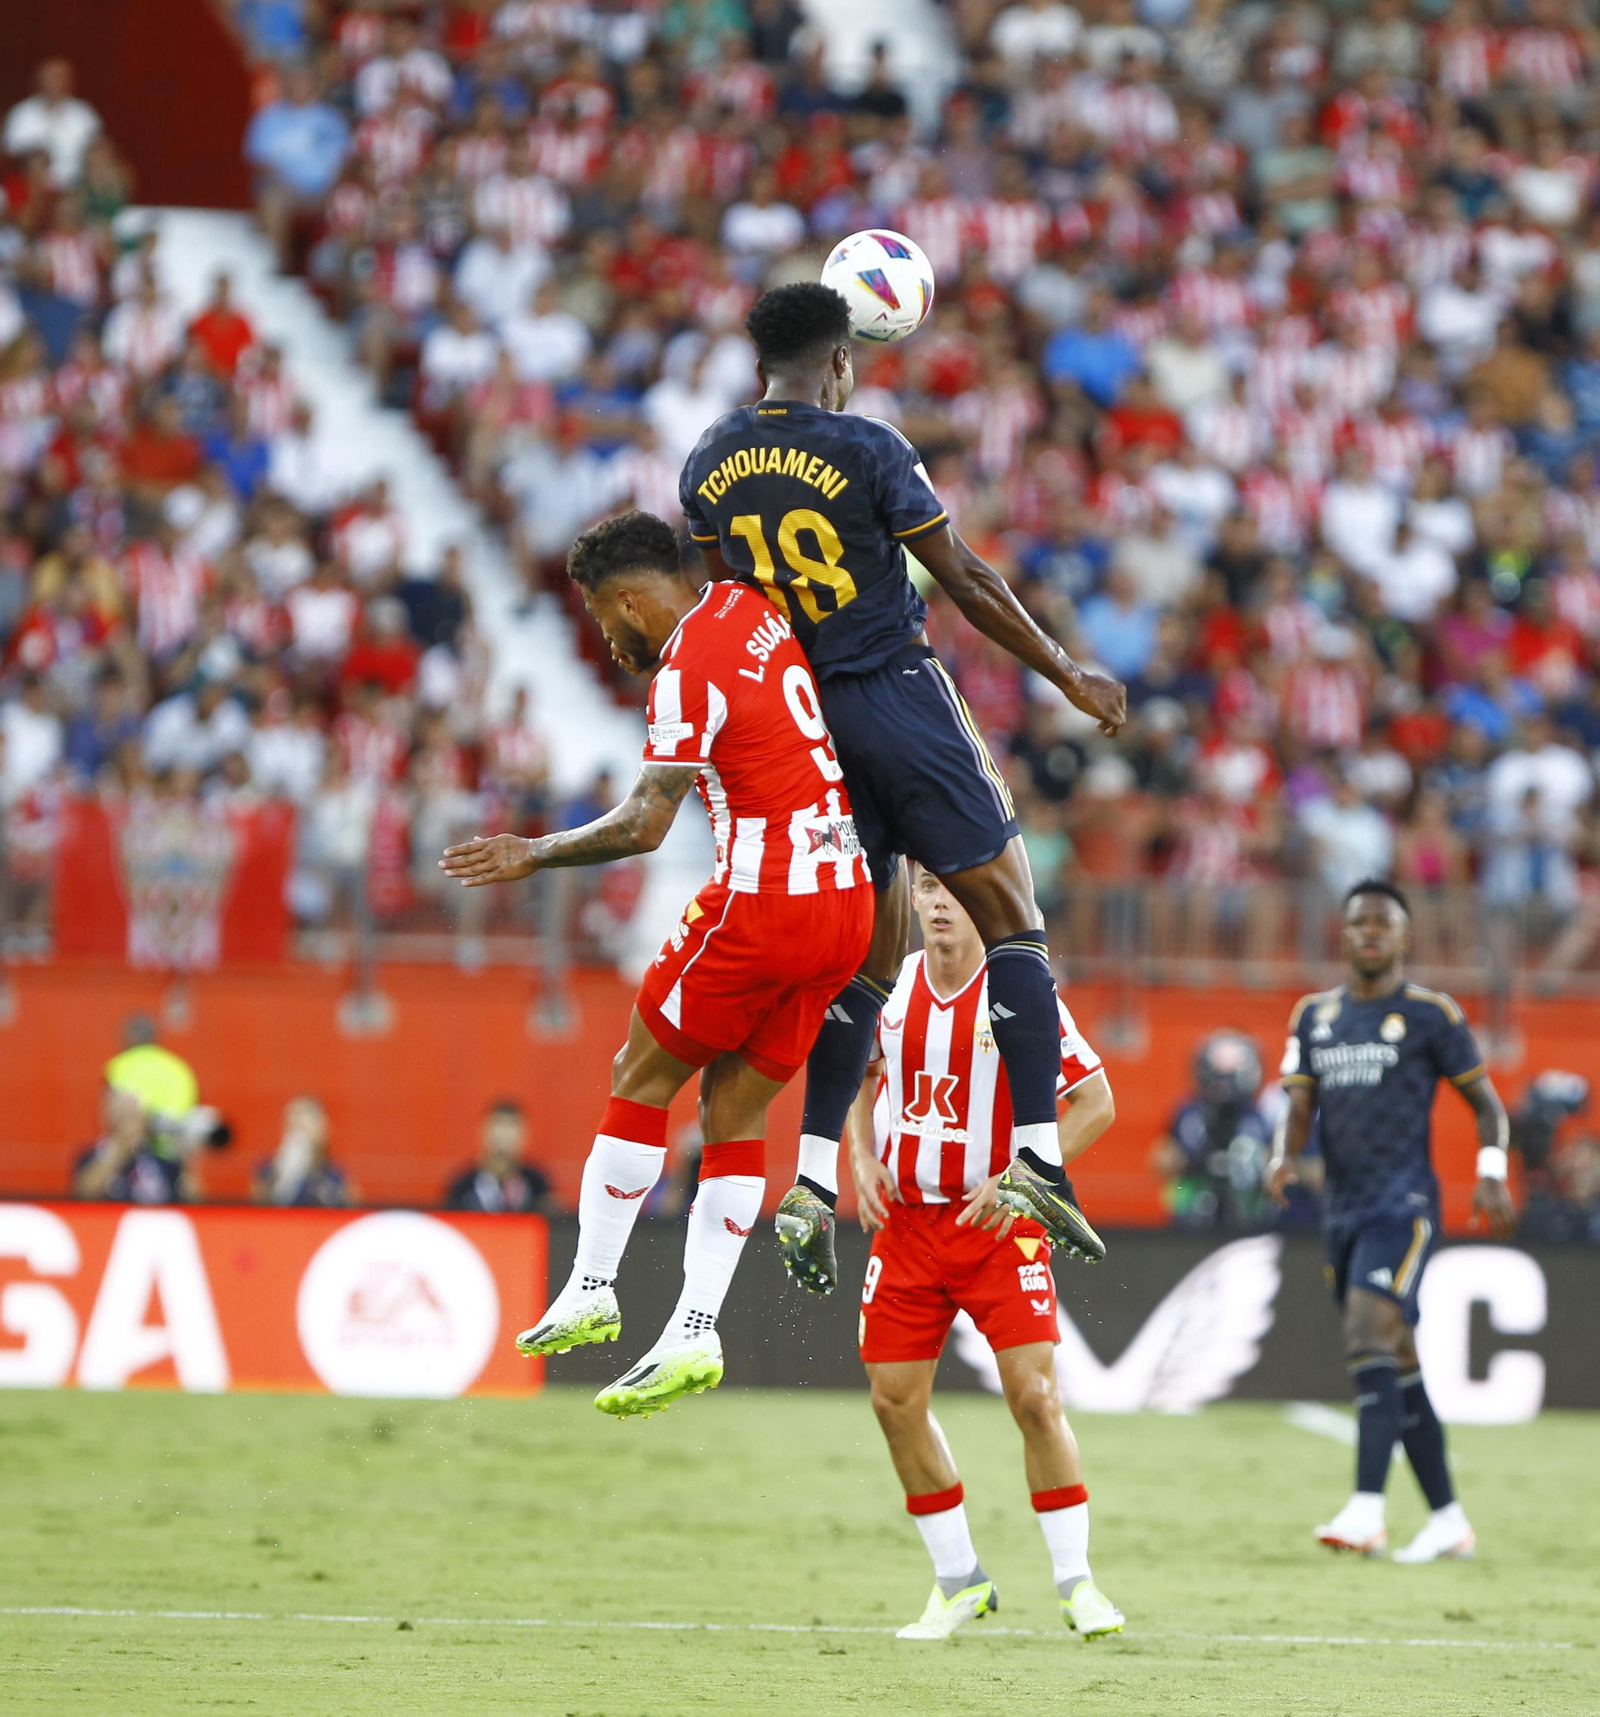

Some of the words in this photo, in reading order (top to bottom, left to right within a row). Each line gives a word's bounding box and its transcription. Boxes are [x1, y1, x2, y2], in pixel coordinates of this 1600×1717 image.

[697, 447, 849, 505] TCHOUAMENI
[730, 508, 858, 624] 18
[738, 664, 765, 684] L.
[783, 664, 844, 782] 9
[906, 1072, 958, 1121] JK
[862, 1255, 883, 1305] 9
